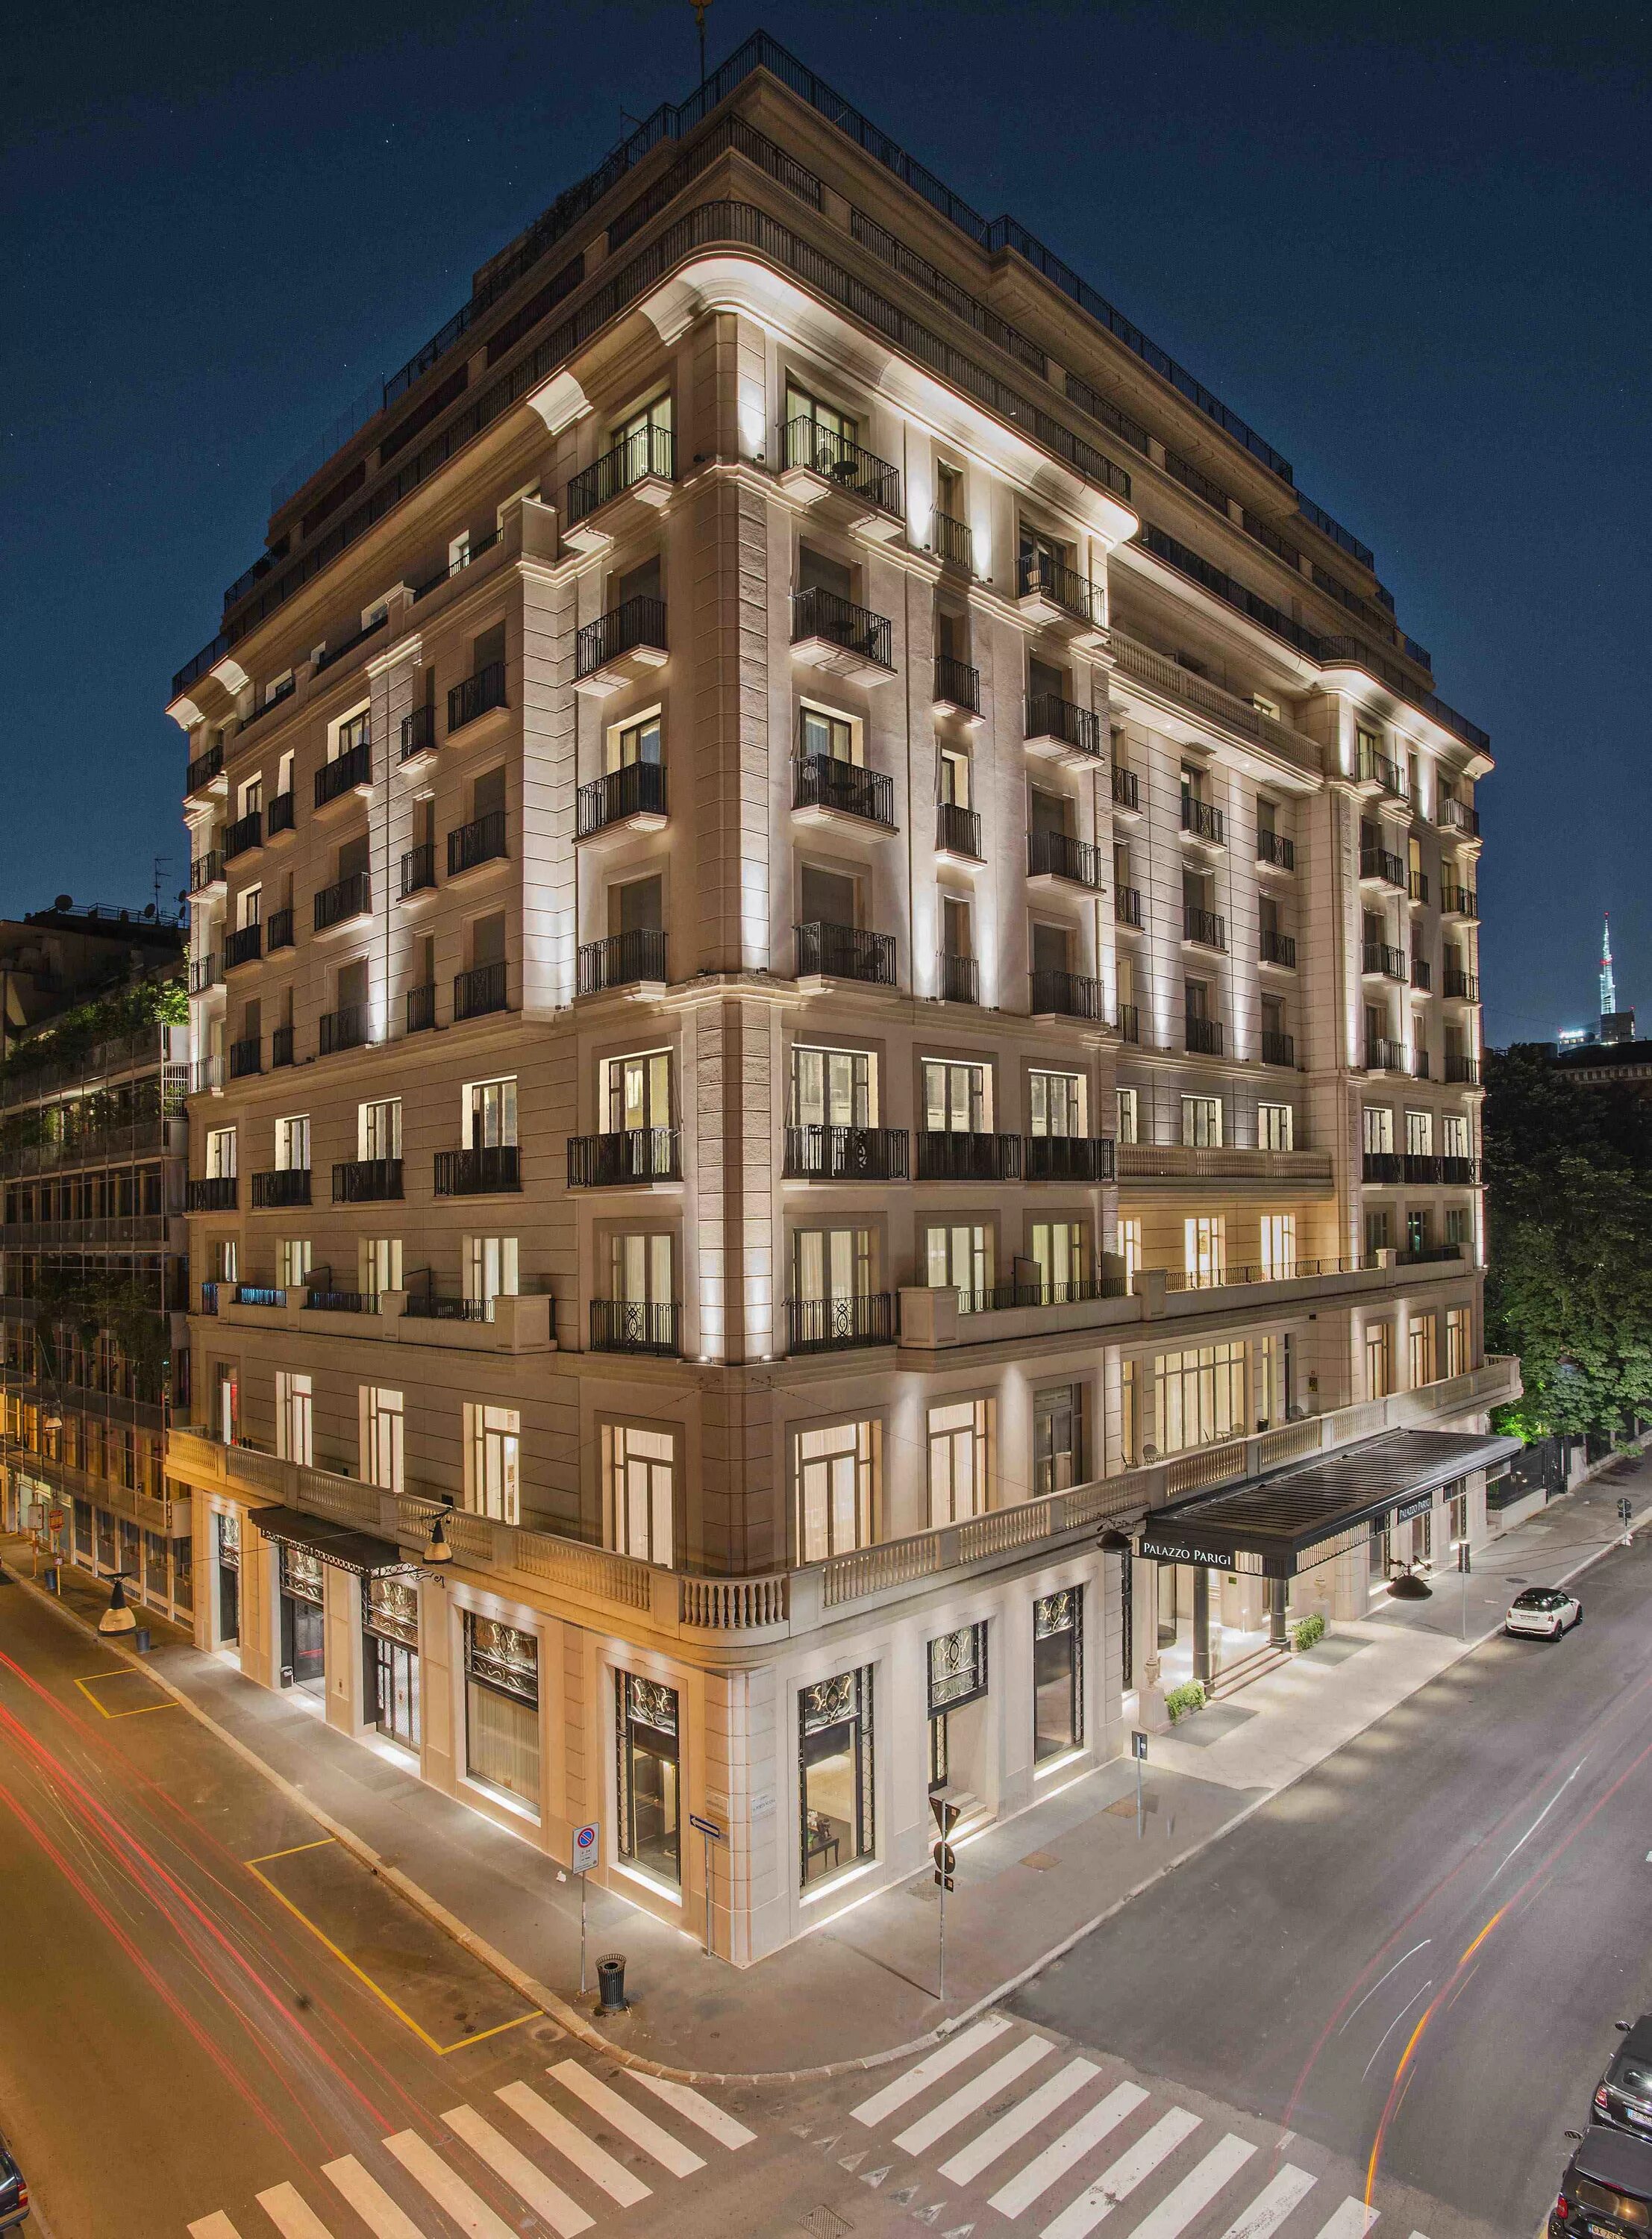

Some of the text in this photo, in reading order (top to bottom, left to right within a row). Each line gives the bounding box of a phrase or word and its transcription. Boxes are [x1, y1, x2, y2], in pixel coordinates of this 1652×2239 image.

[1399, 1504, 1418, 1520] PALAZZO
[1144, 1542, 1231, 1565] PALAZZO PARIGI
